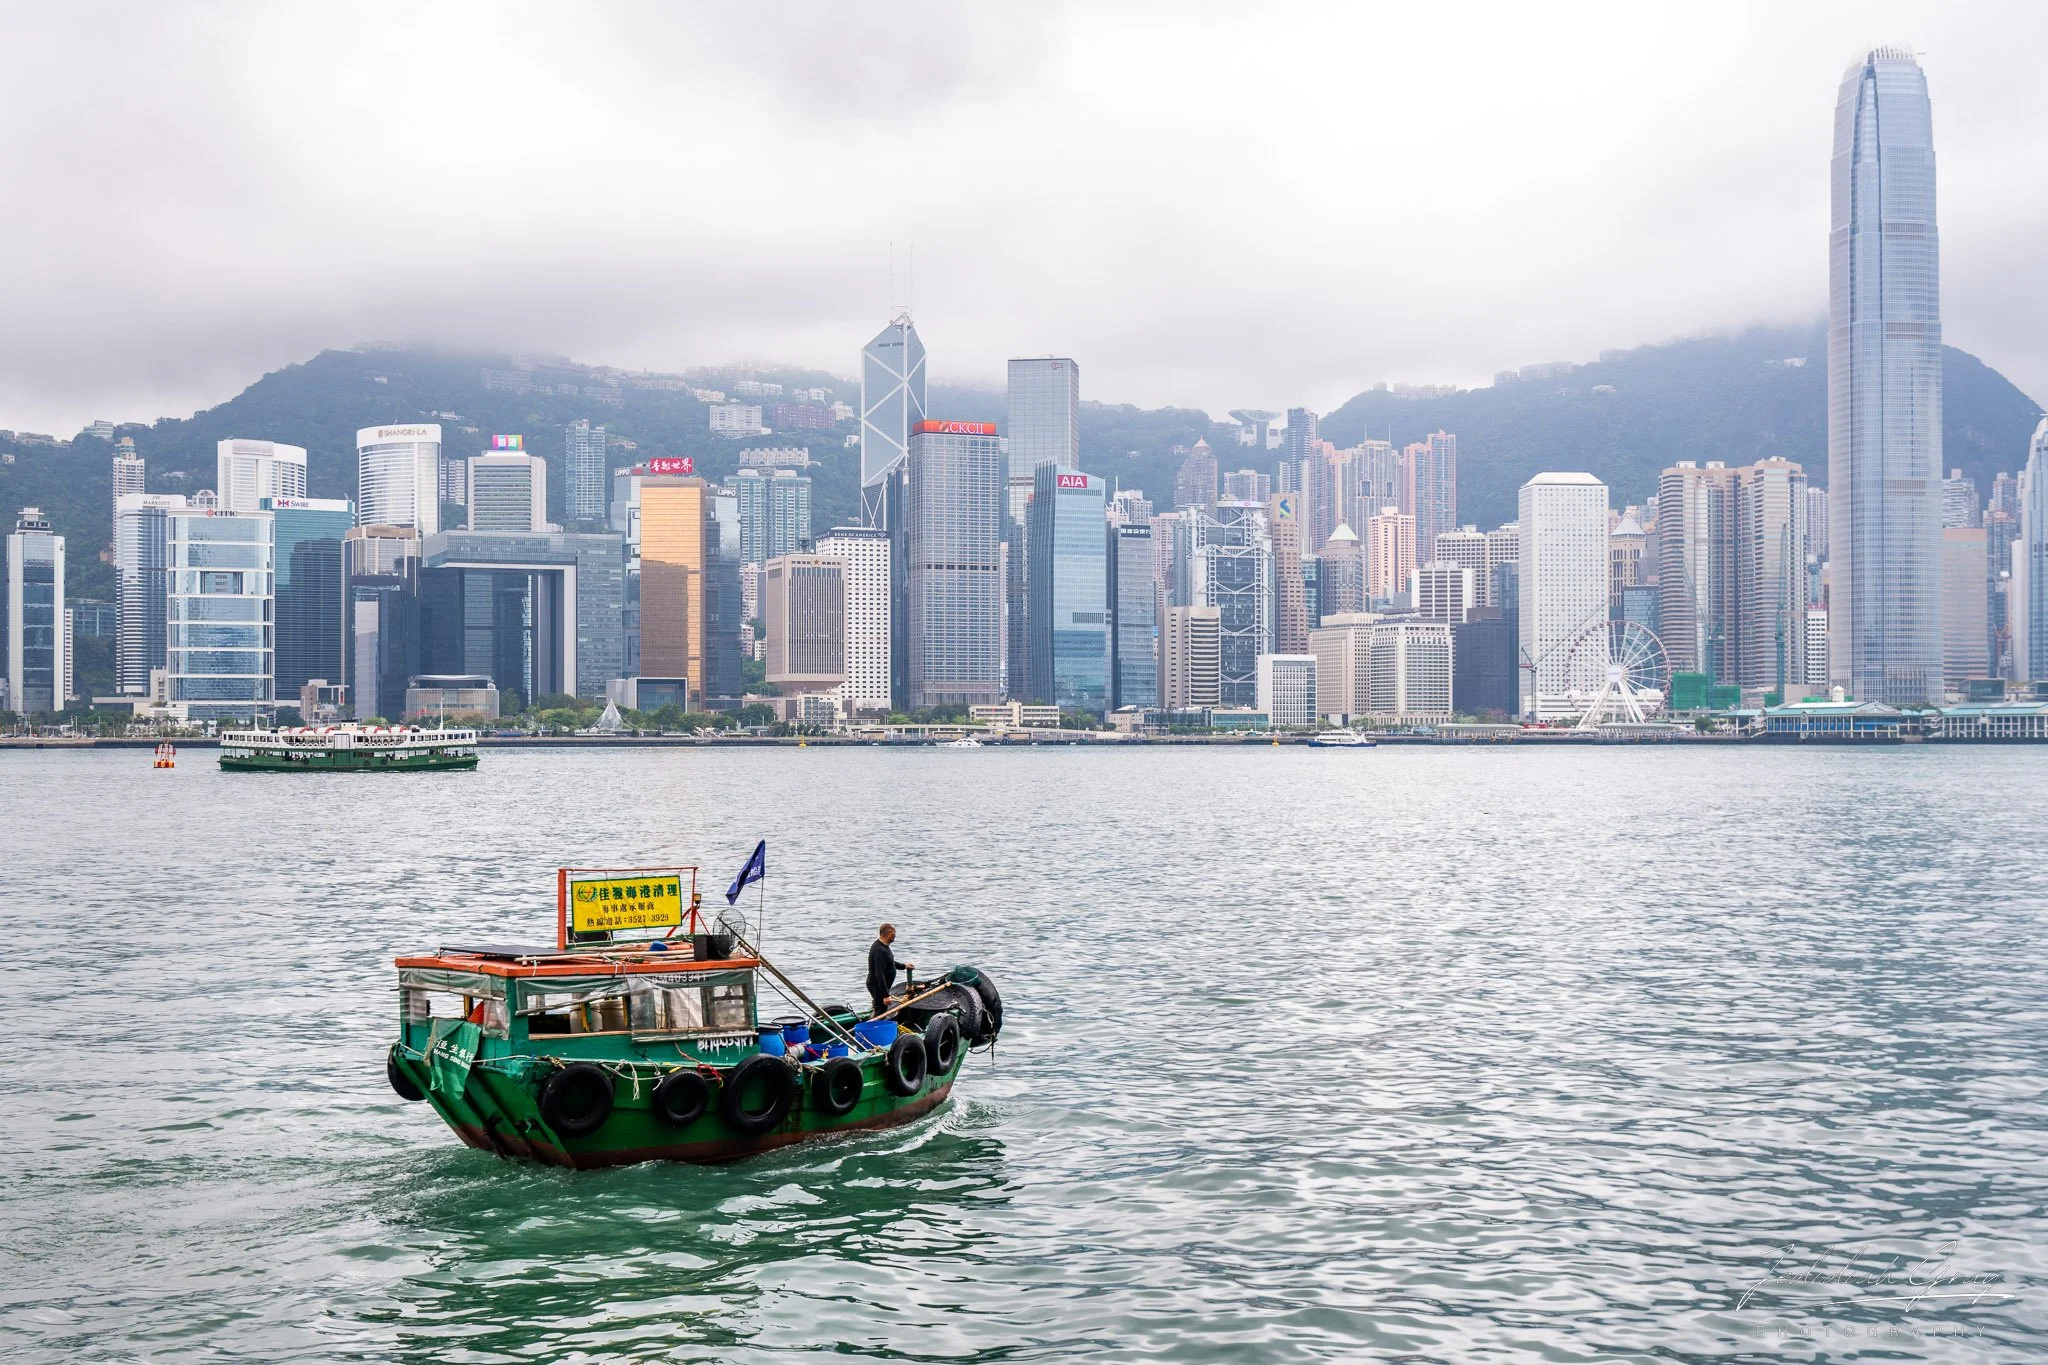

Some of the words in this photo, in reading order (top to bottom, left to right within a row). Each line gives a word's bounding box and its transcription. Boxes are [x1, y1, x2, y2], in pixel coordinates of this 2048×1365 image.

[384, 429, 428, 437] SHANGRI-LA
[614, 468, 630, 476] LIPPO
[1061, 476, 1084, 487] AIA
[717, 489, 737, 497] LIPPO
[433, 1048, 449, 1059] HANG
